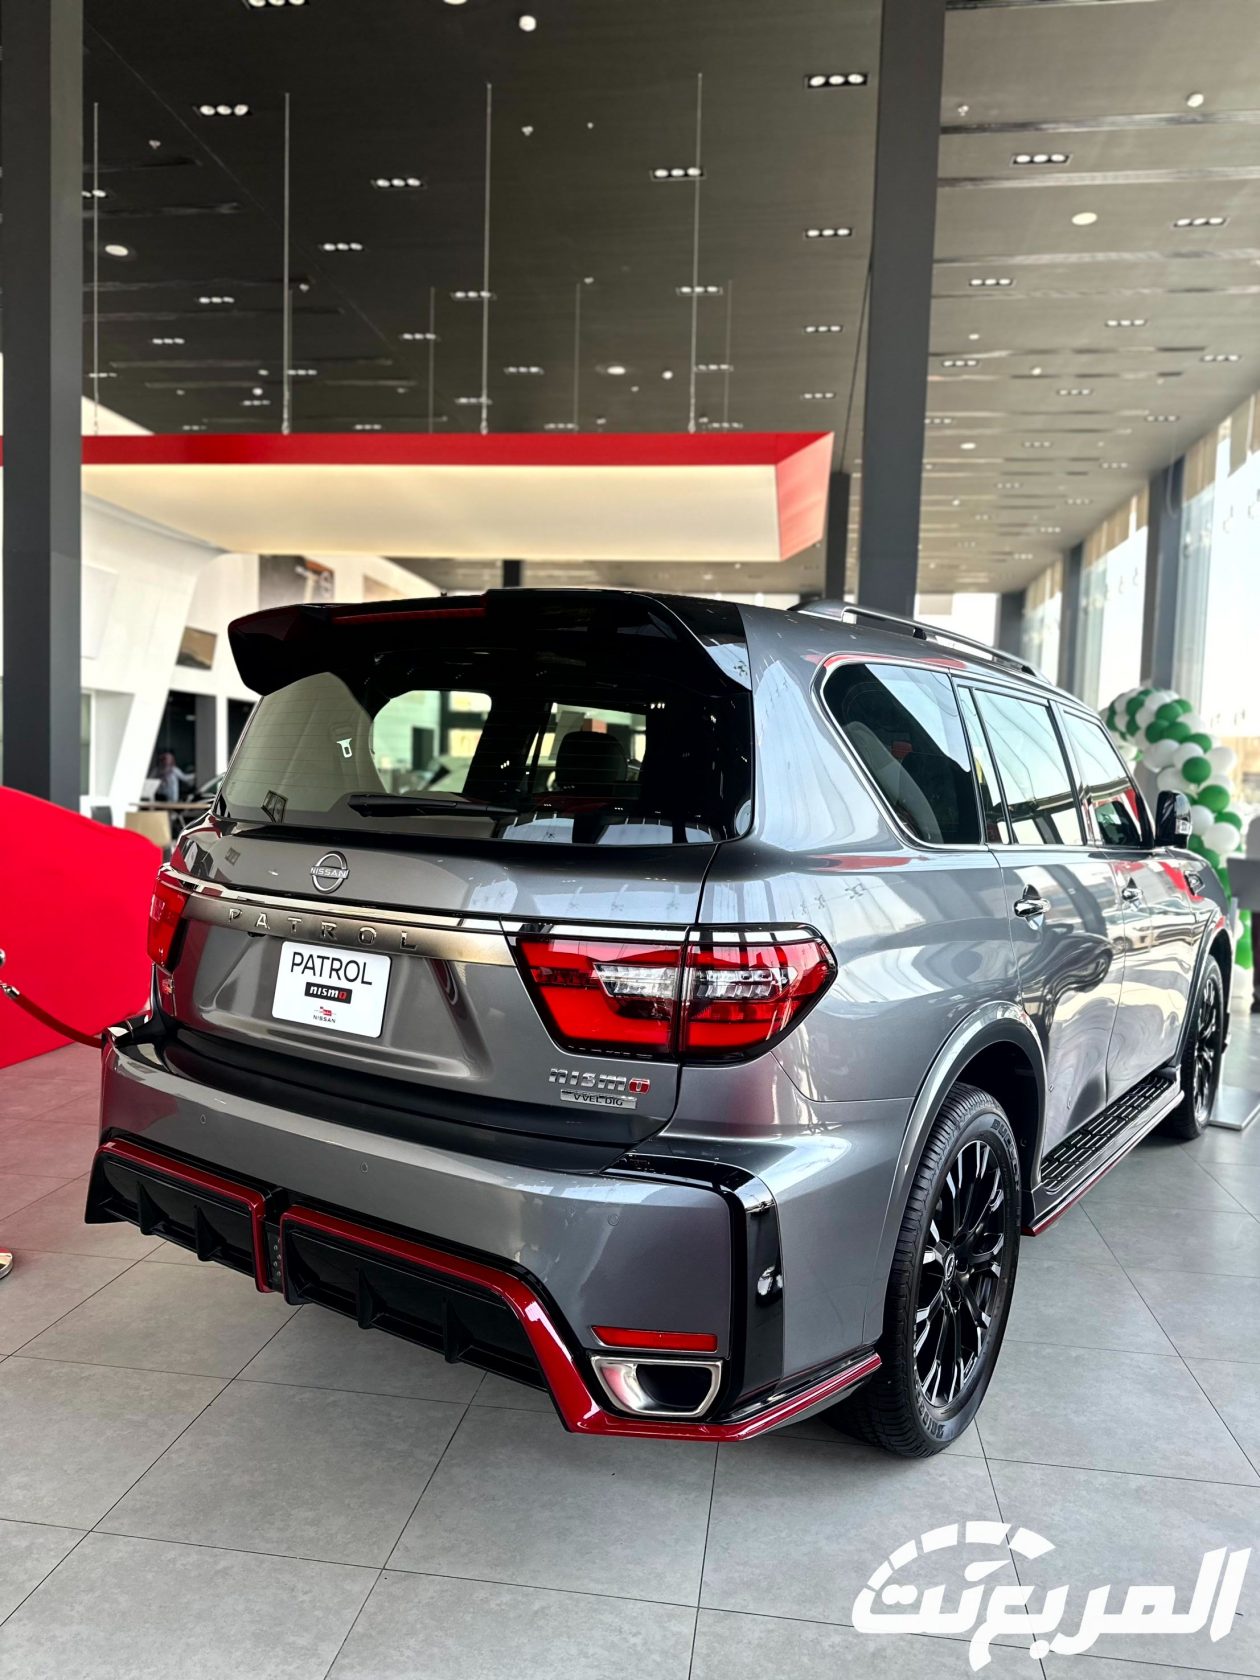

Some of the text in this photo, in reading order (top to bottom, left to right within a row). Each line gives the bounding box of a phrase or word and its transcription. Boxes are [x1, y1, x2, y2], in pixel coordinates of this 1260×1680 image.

[310, 867, 350, 879] NISSAN
[228, 908, 417, 950] PATROL
[290, 951, 373, 986] PATROL
[309, 984, 348, 1000] nismo
[312, 1014, 337, 1024] NISSAN
[548, 1068, 650, 1095] nismo
[604, 1097, 624, 1107] DIG
